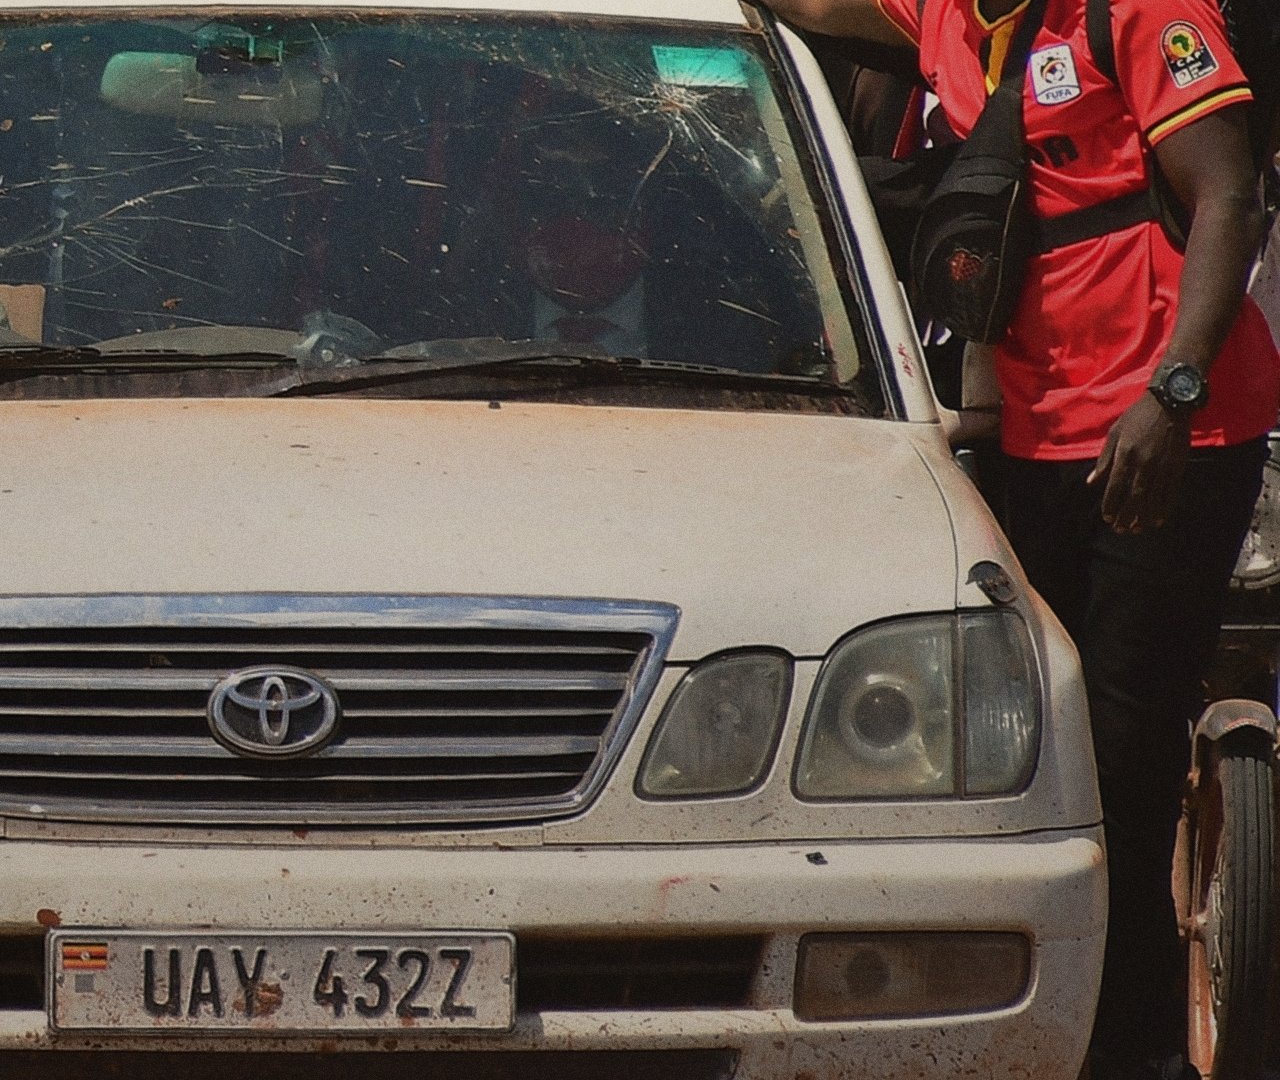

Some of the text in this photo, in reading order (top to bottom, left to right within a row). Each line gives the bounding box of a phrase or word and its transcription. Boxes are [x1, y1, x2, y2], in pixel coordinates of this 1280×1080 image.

[1044, 88, 1072, 100] FUFA
[143, 947, 476, 1018] UAY 432Z
